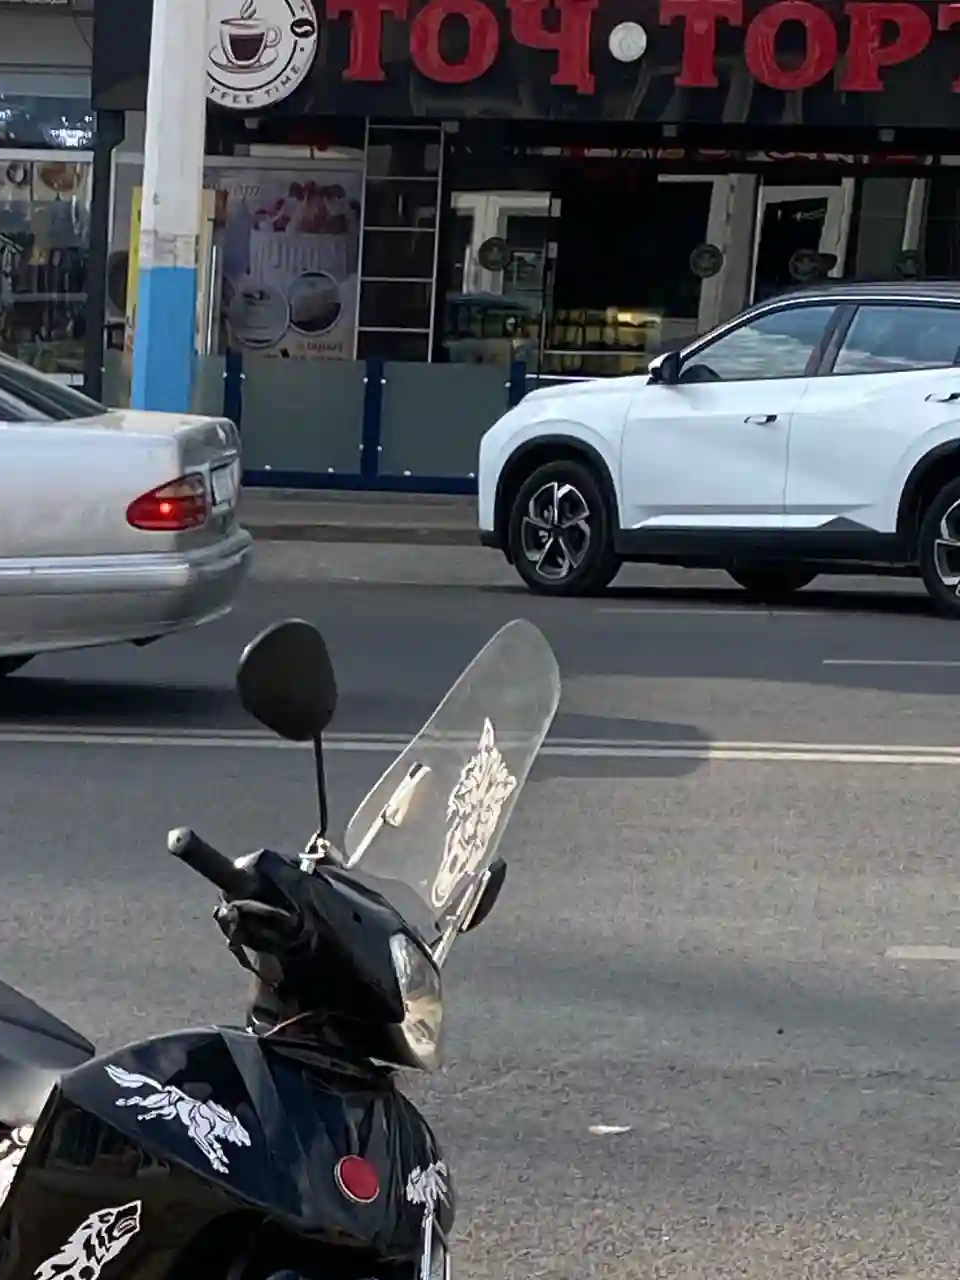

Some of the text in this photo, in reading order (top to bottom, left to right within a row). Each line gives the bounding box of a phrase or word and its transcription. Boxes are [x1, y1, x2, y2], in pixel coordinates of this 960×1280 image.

[326, 0, 960, 95] ТОЧ ТОР
[264, 63, 301, 98] TIME
